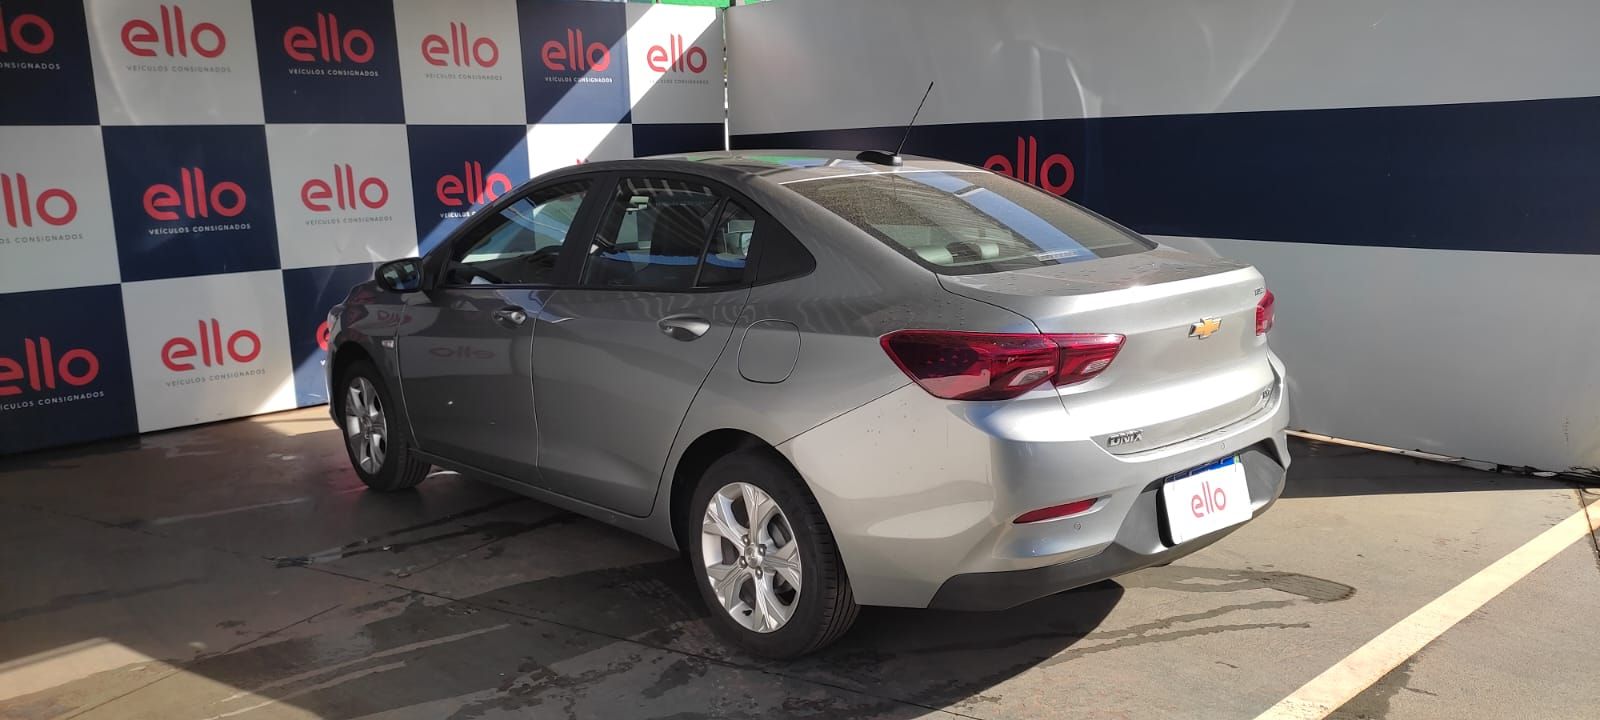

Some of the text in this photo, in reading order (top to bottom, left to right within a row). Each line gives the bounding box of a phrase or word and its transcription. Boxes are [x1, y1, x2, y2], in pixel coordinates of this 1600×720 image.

[120, 5, 226, 58] ello
[283, 12, 374, 63] ello
[421, 22, 499, 69] ello
[541, 28, 611, 72] ello
[172, 65, 232, 74] CONSIGNADOS
[647, 33, 706, 73] ello
[328, 69, 379, 78] CONSIGNADOS
[142, 167, 246, 221] ello
[301, 164, 389, 212] ello
[437, 161, 512, 206] ello
[15, 233, 84, 244] CONSIGNADOS
[148, 223, 252, 236] VEÍCULOS CONSIGNADOS
[343, 215, 393, 224] CONSIGNADOS
[161, 318, 261, 372] ello
[209, 368, 266, 382] CONSIGNADOS
[38, 391, 105, 406] CONSIGNADOS
[1191, 481, 1226, 518] ello
